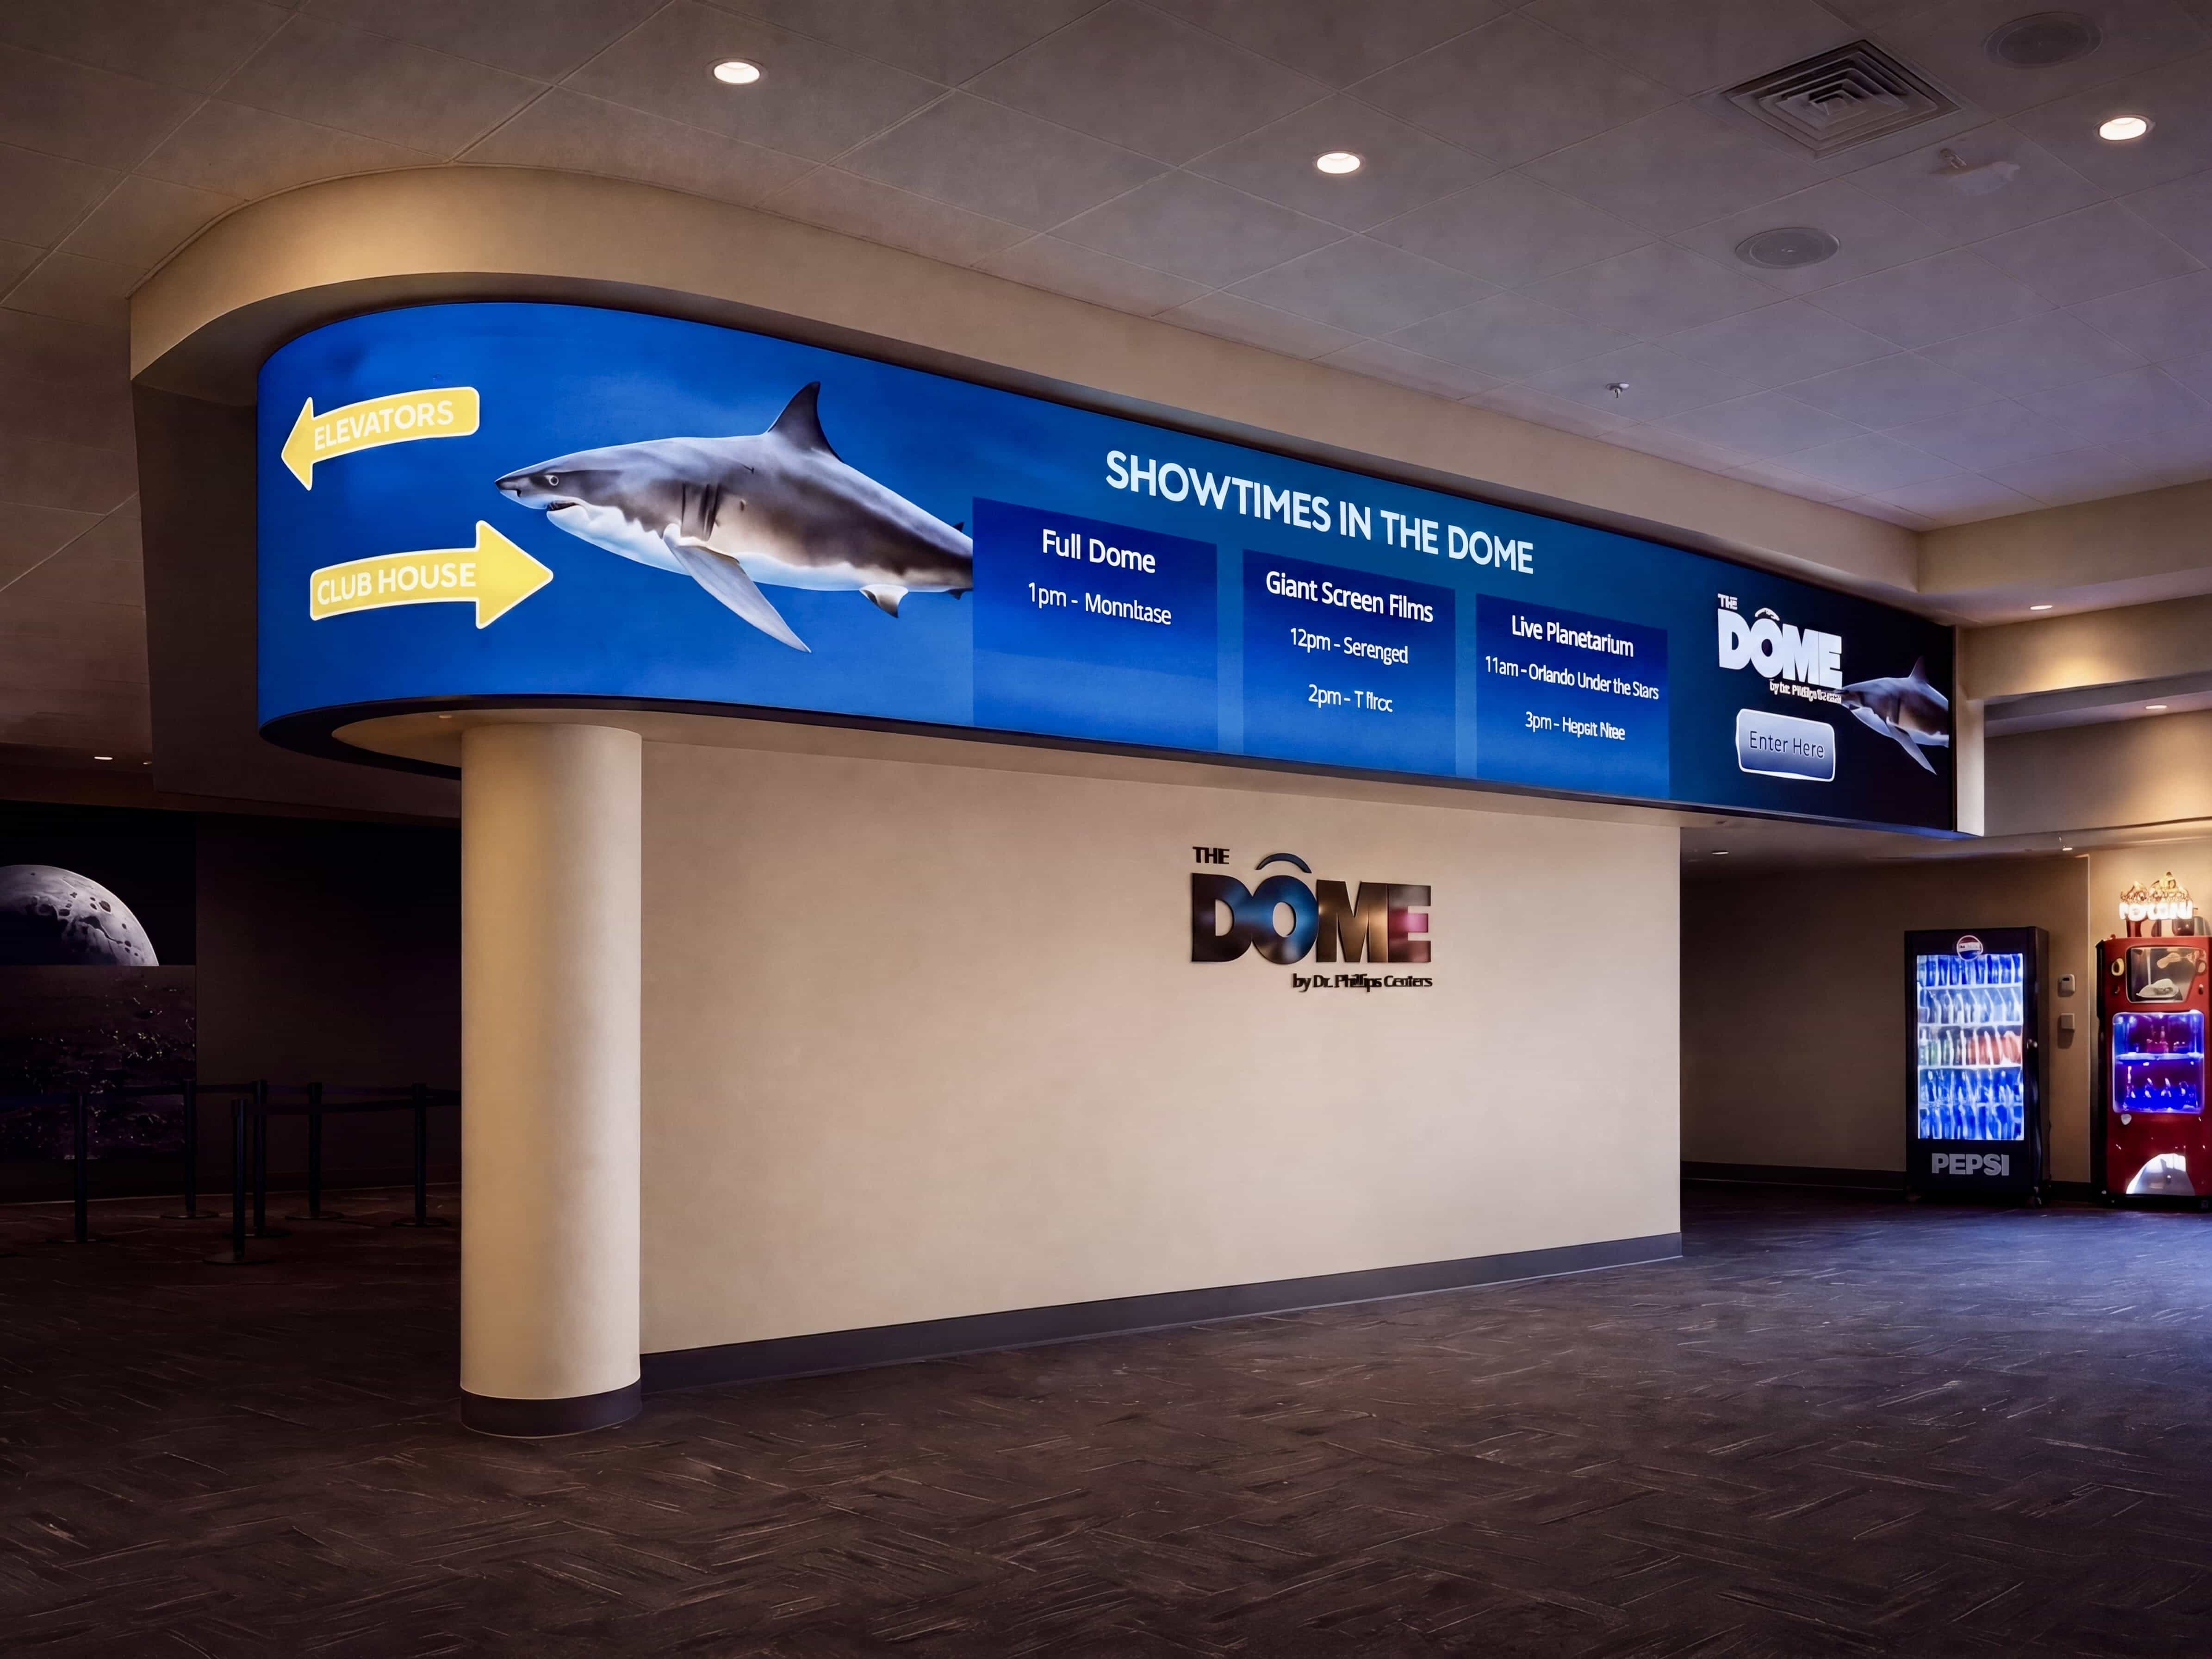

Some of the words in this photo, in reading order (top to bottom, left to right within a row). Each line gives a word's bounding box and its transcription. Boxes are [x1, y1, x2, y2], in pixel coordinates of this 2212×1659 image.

[314, 400, 454, 451] ELEVATORS
[1106, 450, 1331, 532] SHOWTIMES
[1340, 501, 1371, 540] IN
[1380, 510, 1438, 555] THE
[1448, 525, 1533, 574] DOME
[1043, 529, 1081, 560] Full
[1089, 538, 1156, 573] Dome
[317, 572, 372, 605] CLUB
[378, 562, 477, 593] HOUSE
[1029, 582, 1066, 609] 1pm
[1266, 571, 1318, 601] Giant
[1322, 582, 1384, 614] Screen
[1390, 594, 1433, 623] Films
[1717, 593, 1738, 610] THE
[1291, 628, 1330, 653] 12pm
[1344, 636, 1408, 665] Serenged
[1512, 615, 1543, 640] Live
[1547, 622, 1634, 657] Planetarium
[1485, 656, 1518, 677] 11am
[1529, 663, 1575, 686] Orlando
[1578, 672, 1611, 692] Under
[1613, 678, 1631, 695] the
[1309, 684, 1341, 708] 2pm
[1525, 711, 1552, 732] 3pm
[1749, 730, 1788, 752] Enter
[1793, 738, 1824, 758] Here
[1193, 847, 1229, 864] THE
[1293, 973, 1311, 992] by
[1932, 1153, 2009, 1176] PEPSI
